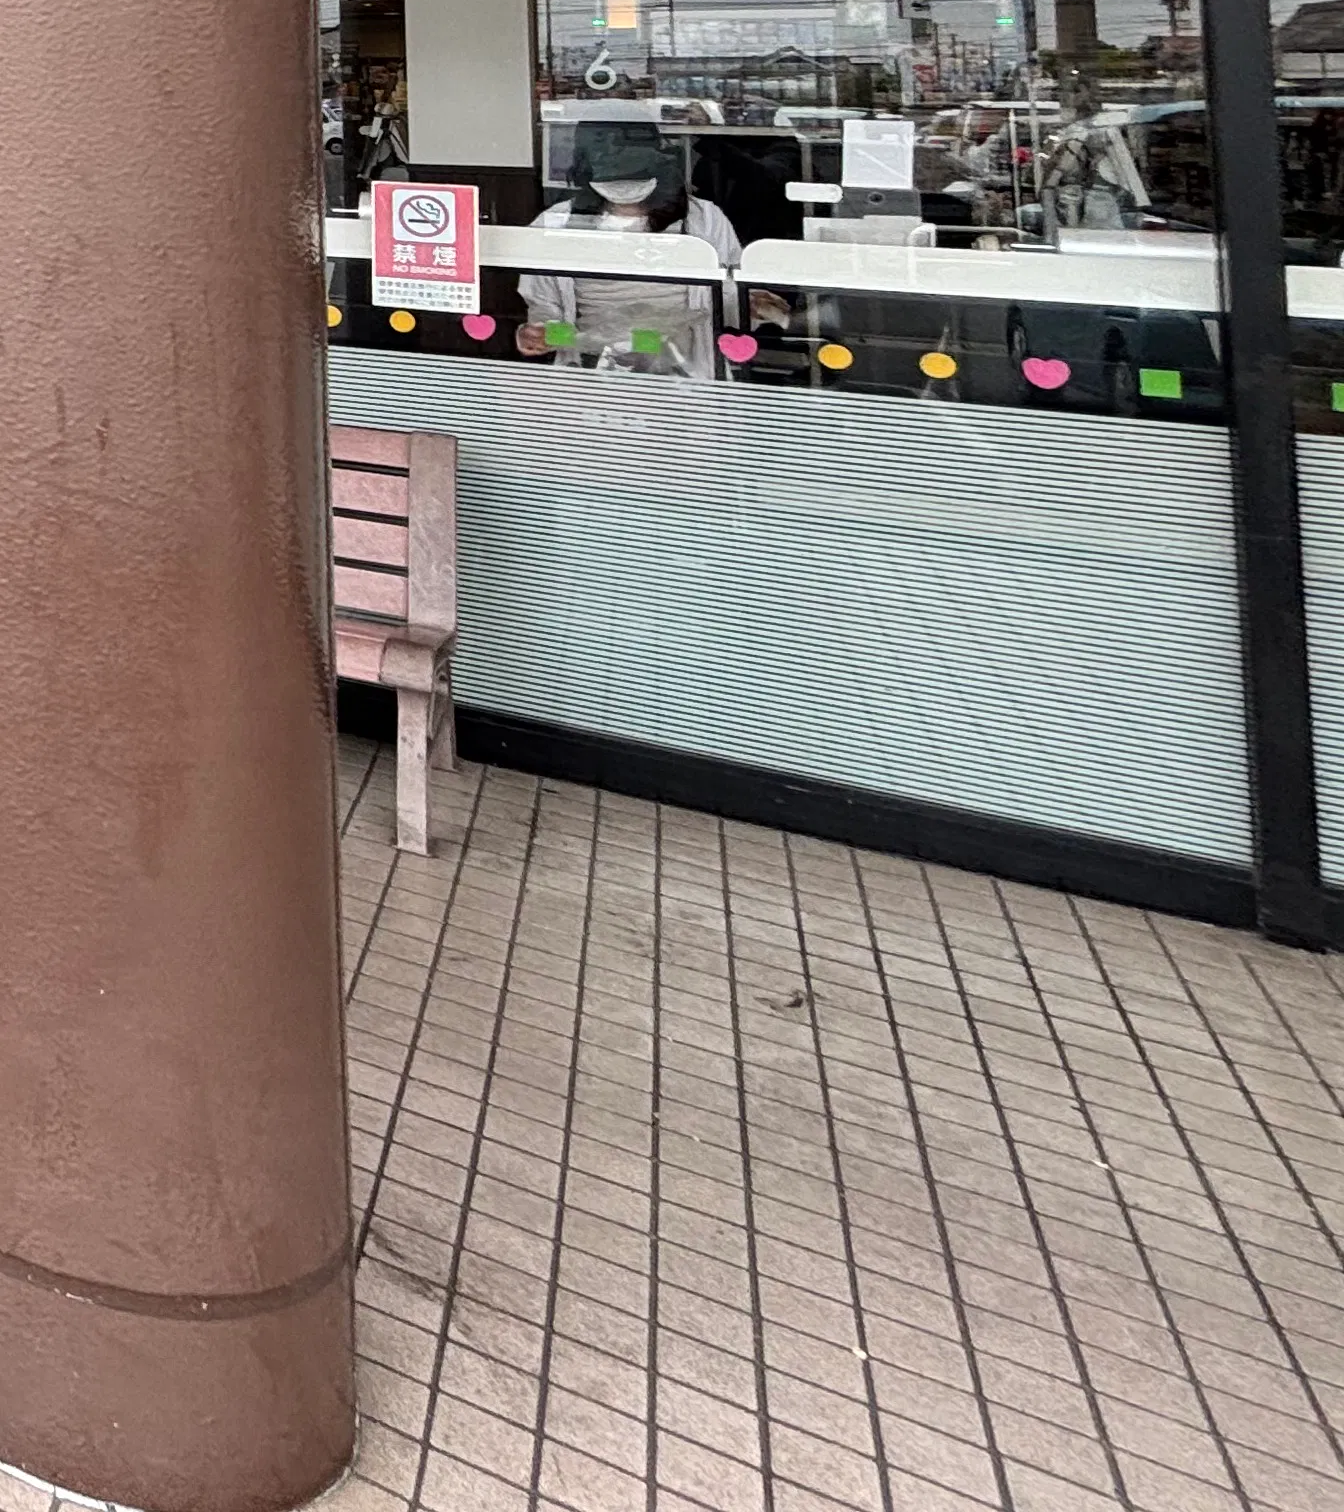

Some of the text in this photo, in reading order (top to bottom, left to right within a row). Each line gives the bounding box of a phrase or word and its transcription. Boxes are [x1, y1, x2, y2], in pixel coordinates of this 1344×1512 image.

[585, 48, 617, 90] 6
[393, 244, 457, 266] 禁煙
[392, 265, 409, 273] NO
